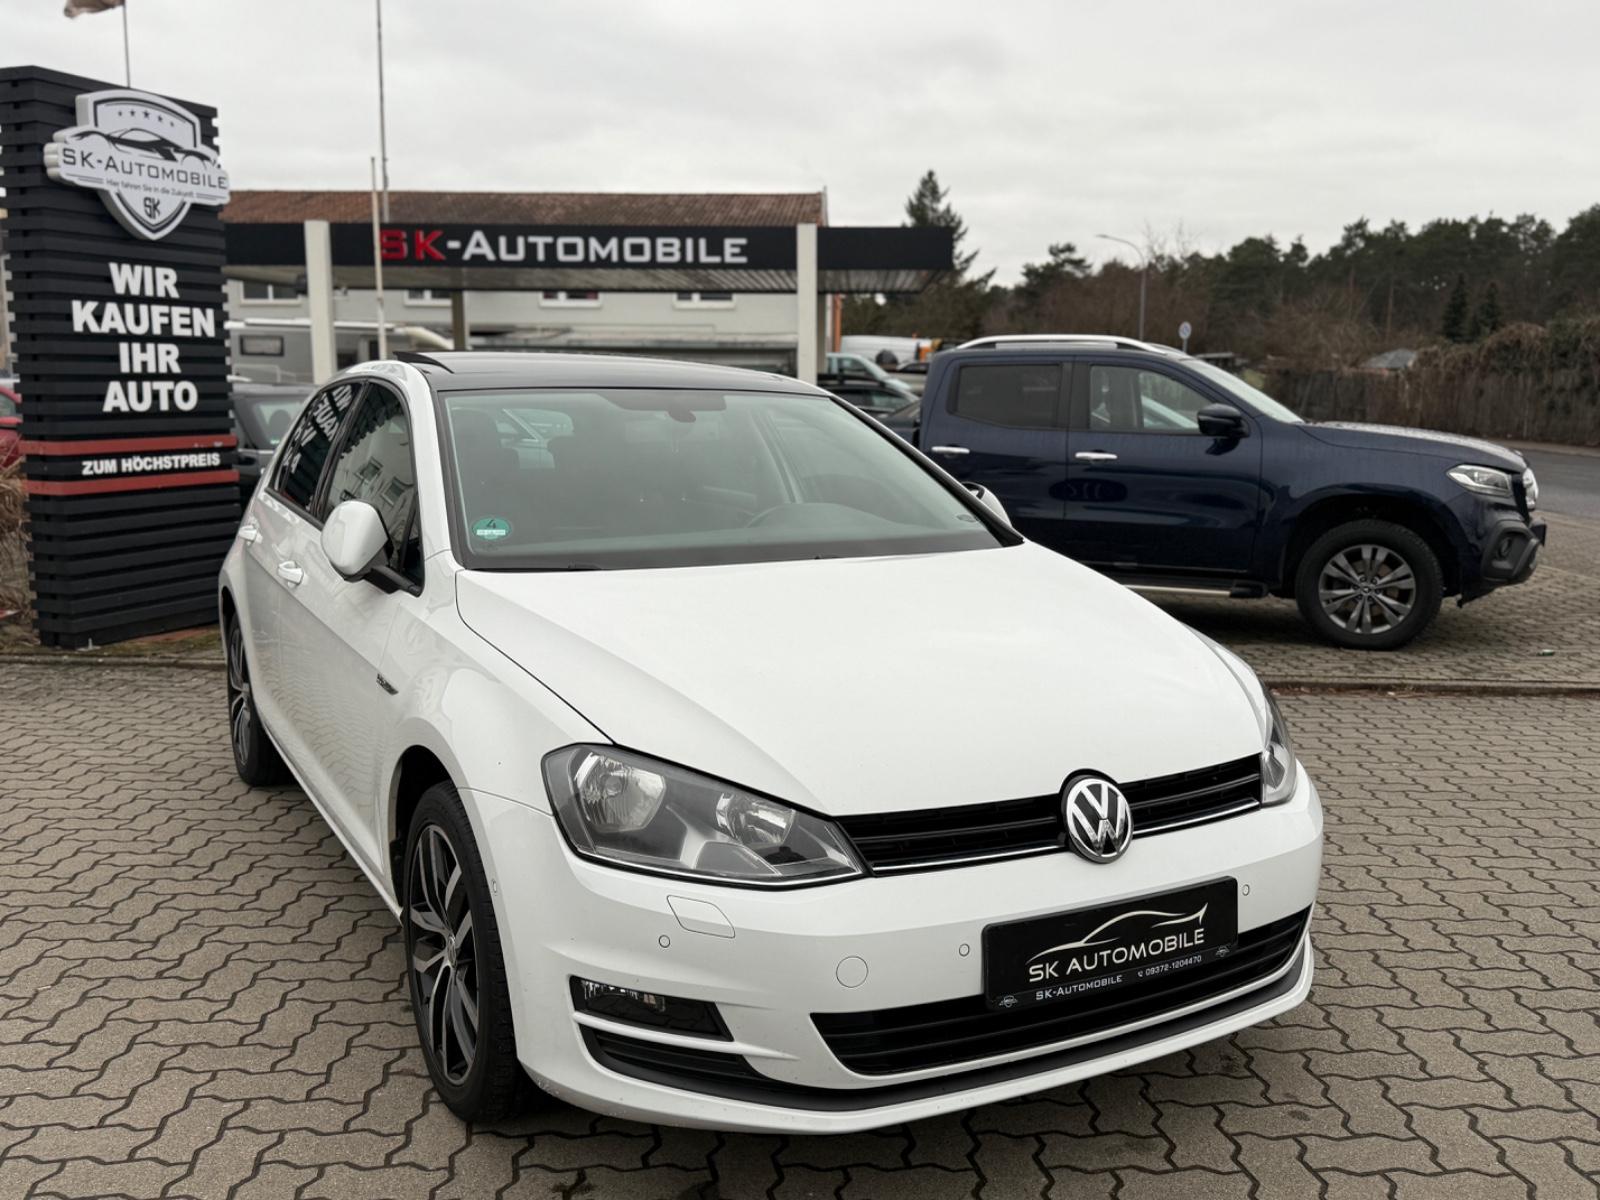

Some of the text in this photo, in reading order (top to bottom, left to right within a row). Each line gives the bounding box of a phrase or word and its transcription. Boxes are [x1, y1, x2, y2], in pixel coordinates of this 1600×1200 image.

[379, 229, 749, 264] SK-AUTOMOBILE
[108, 262, 180, 299] WIR
[71, 299, 216, 338] KAUFEN
[118, 342, 182, 374] IHR
[102, 380, 199, 413] AUTO
[81, 452, 221, 476] ZUM HÖCHSTPREIS
[1028, 927, 1205, 983] SK AUTOMOBILE
[1035, 974, 1123, 1001] SK-AUTOMOBILE
